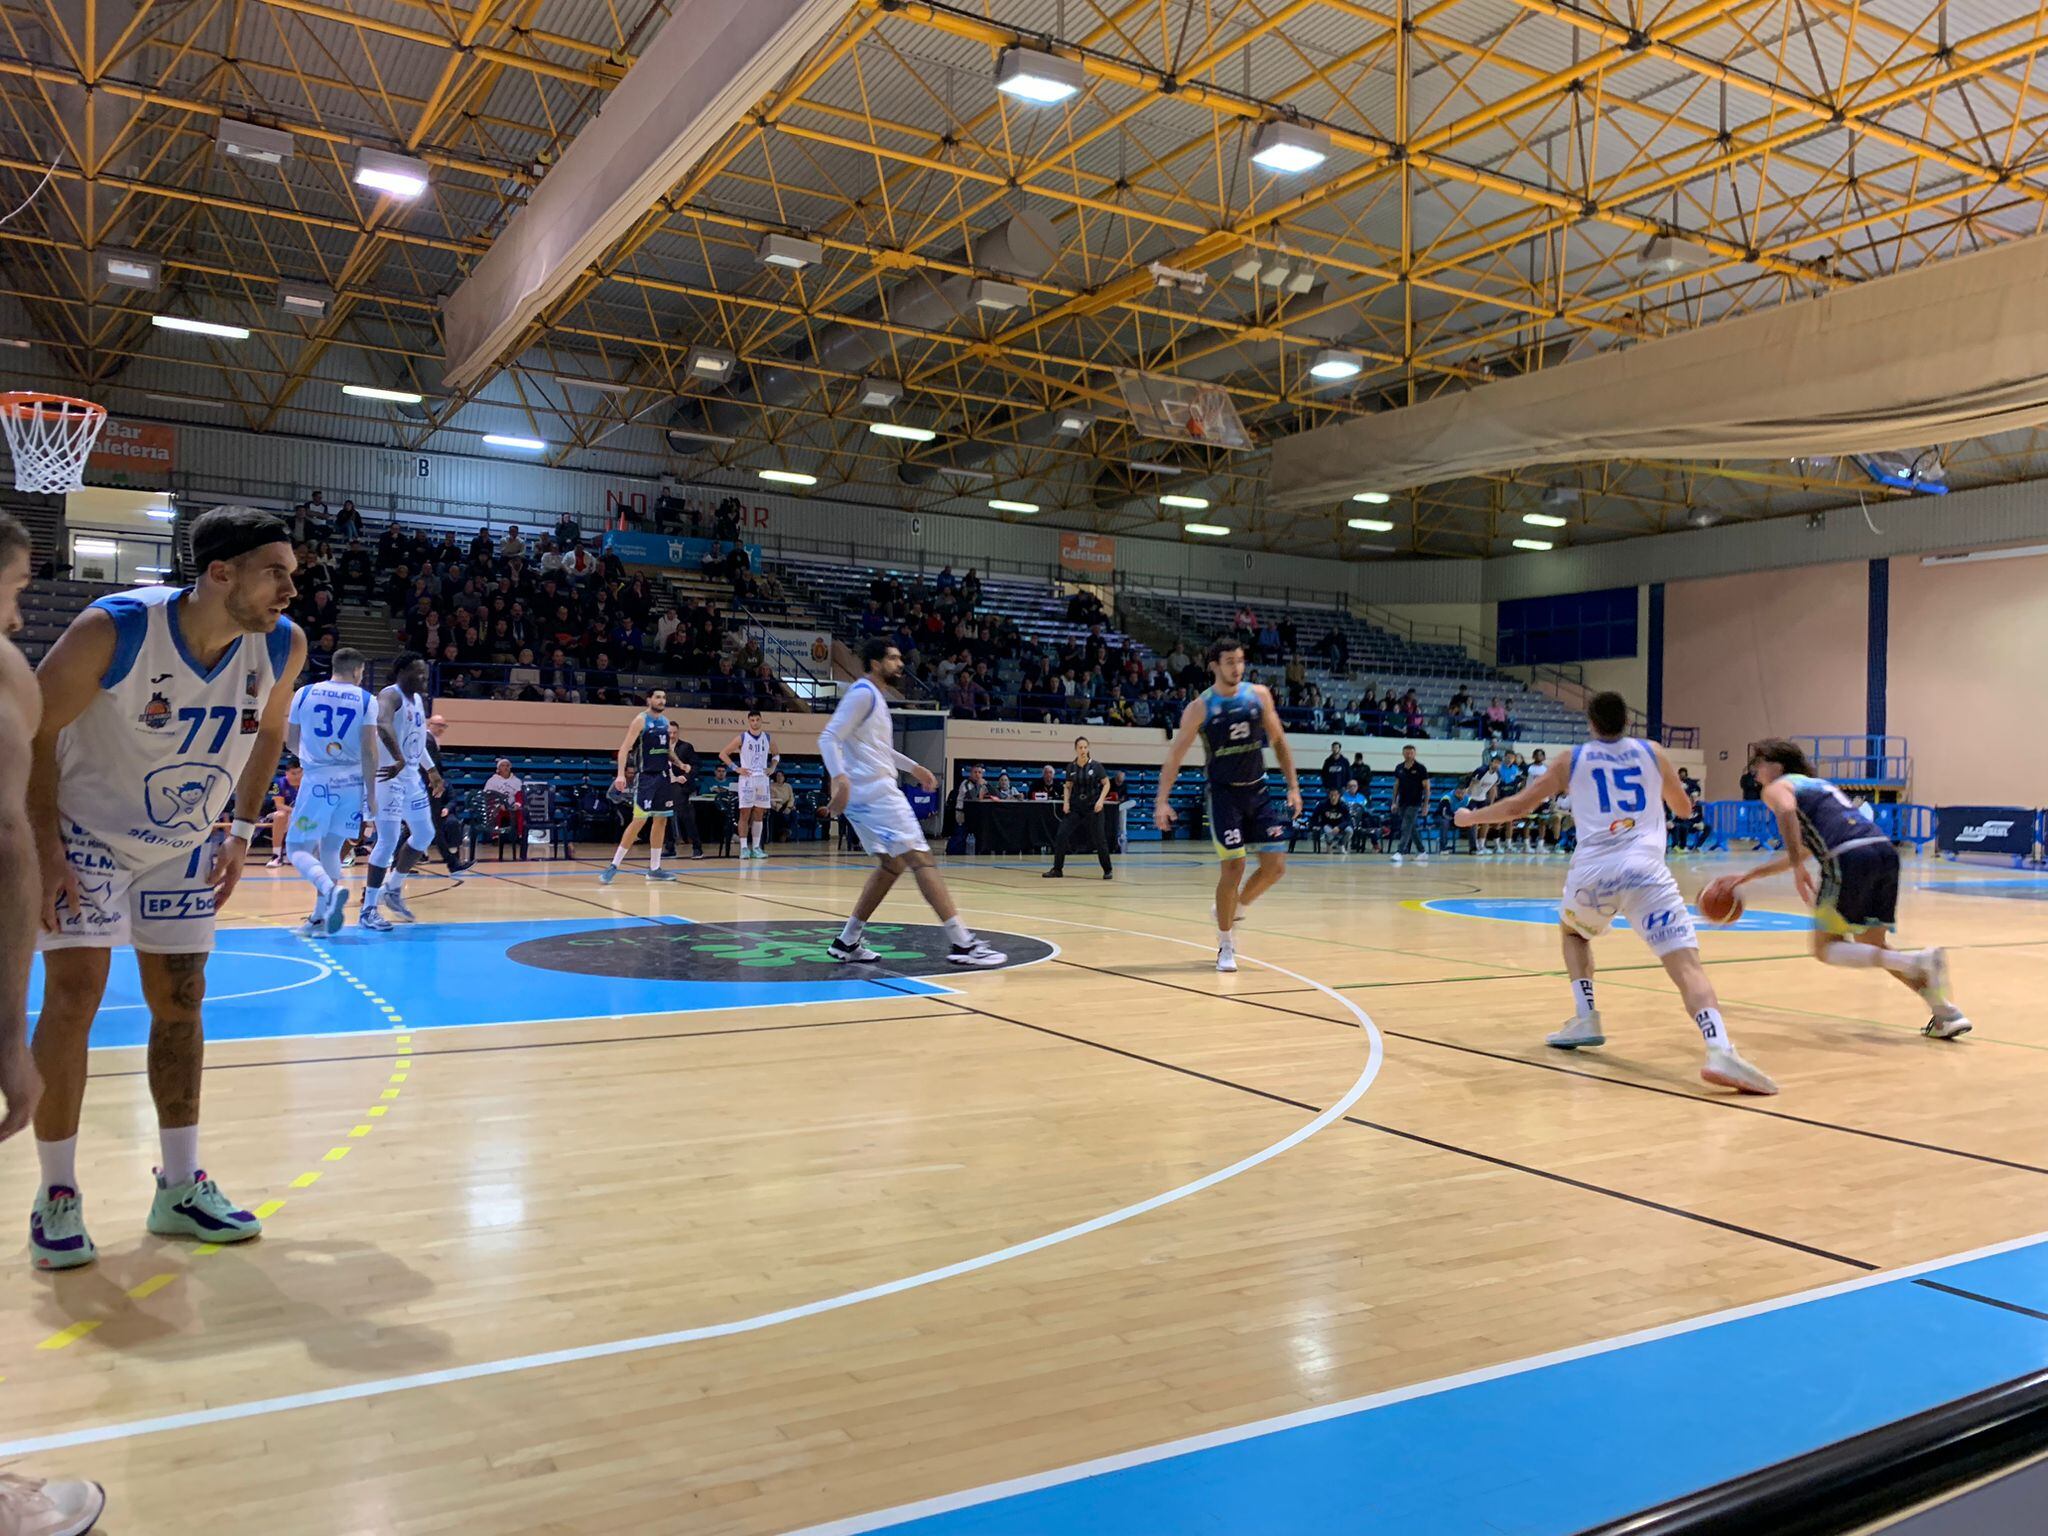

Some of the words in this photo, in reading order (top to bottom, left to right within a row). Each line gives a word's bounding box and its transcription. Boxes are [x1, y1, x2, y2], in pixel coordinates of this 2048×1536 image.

[105, 420, 141, 439] Bar
[93, 438, 169, 460] afetería
[418, 458, 430, 477] B
[606, 489, 647, 516] NO
[912, 518, 920, 534] C
[176, 706, 238, 754] 77
[313, 704, 357, 740] 37
[707, 716, 746, 726] PRENSA
[990, 727, 1021, 736] PRENSA
[1591, 766, 1647, 813] 15
[1224, 828, 1241, 846] 29
